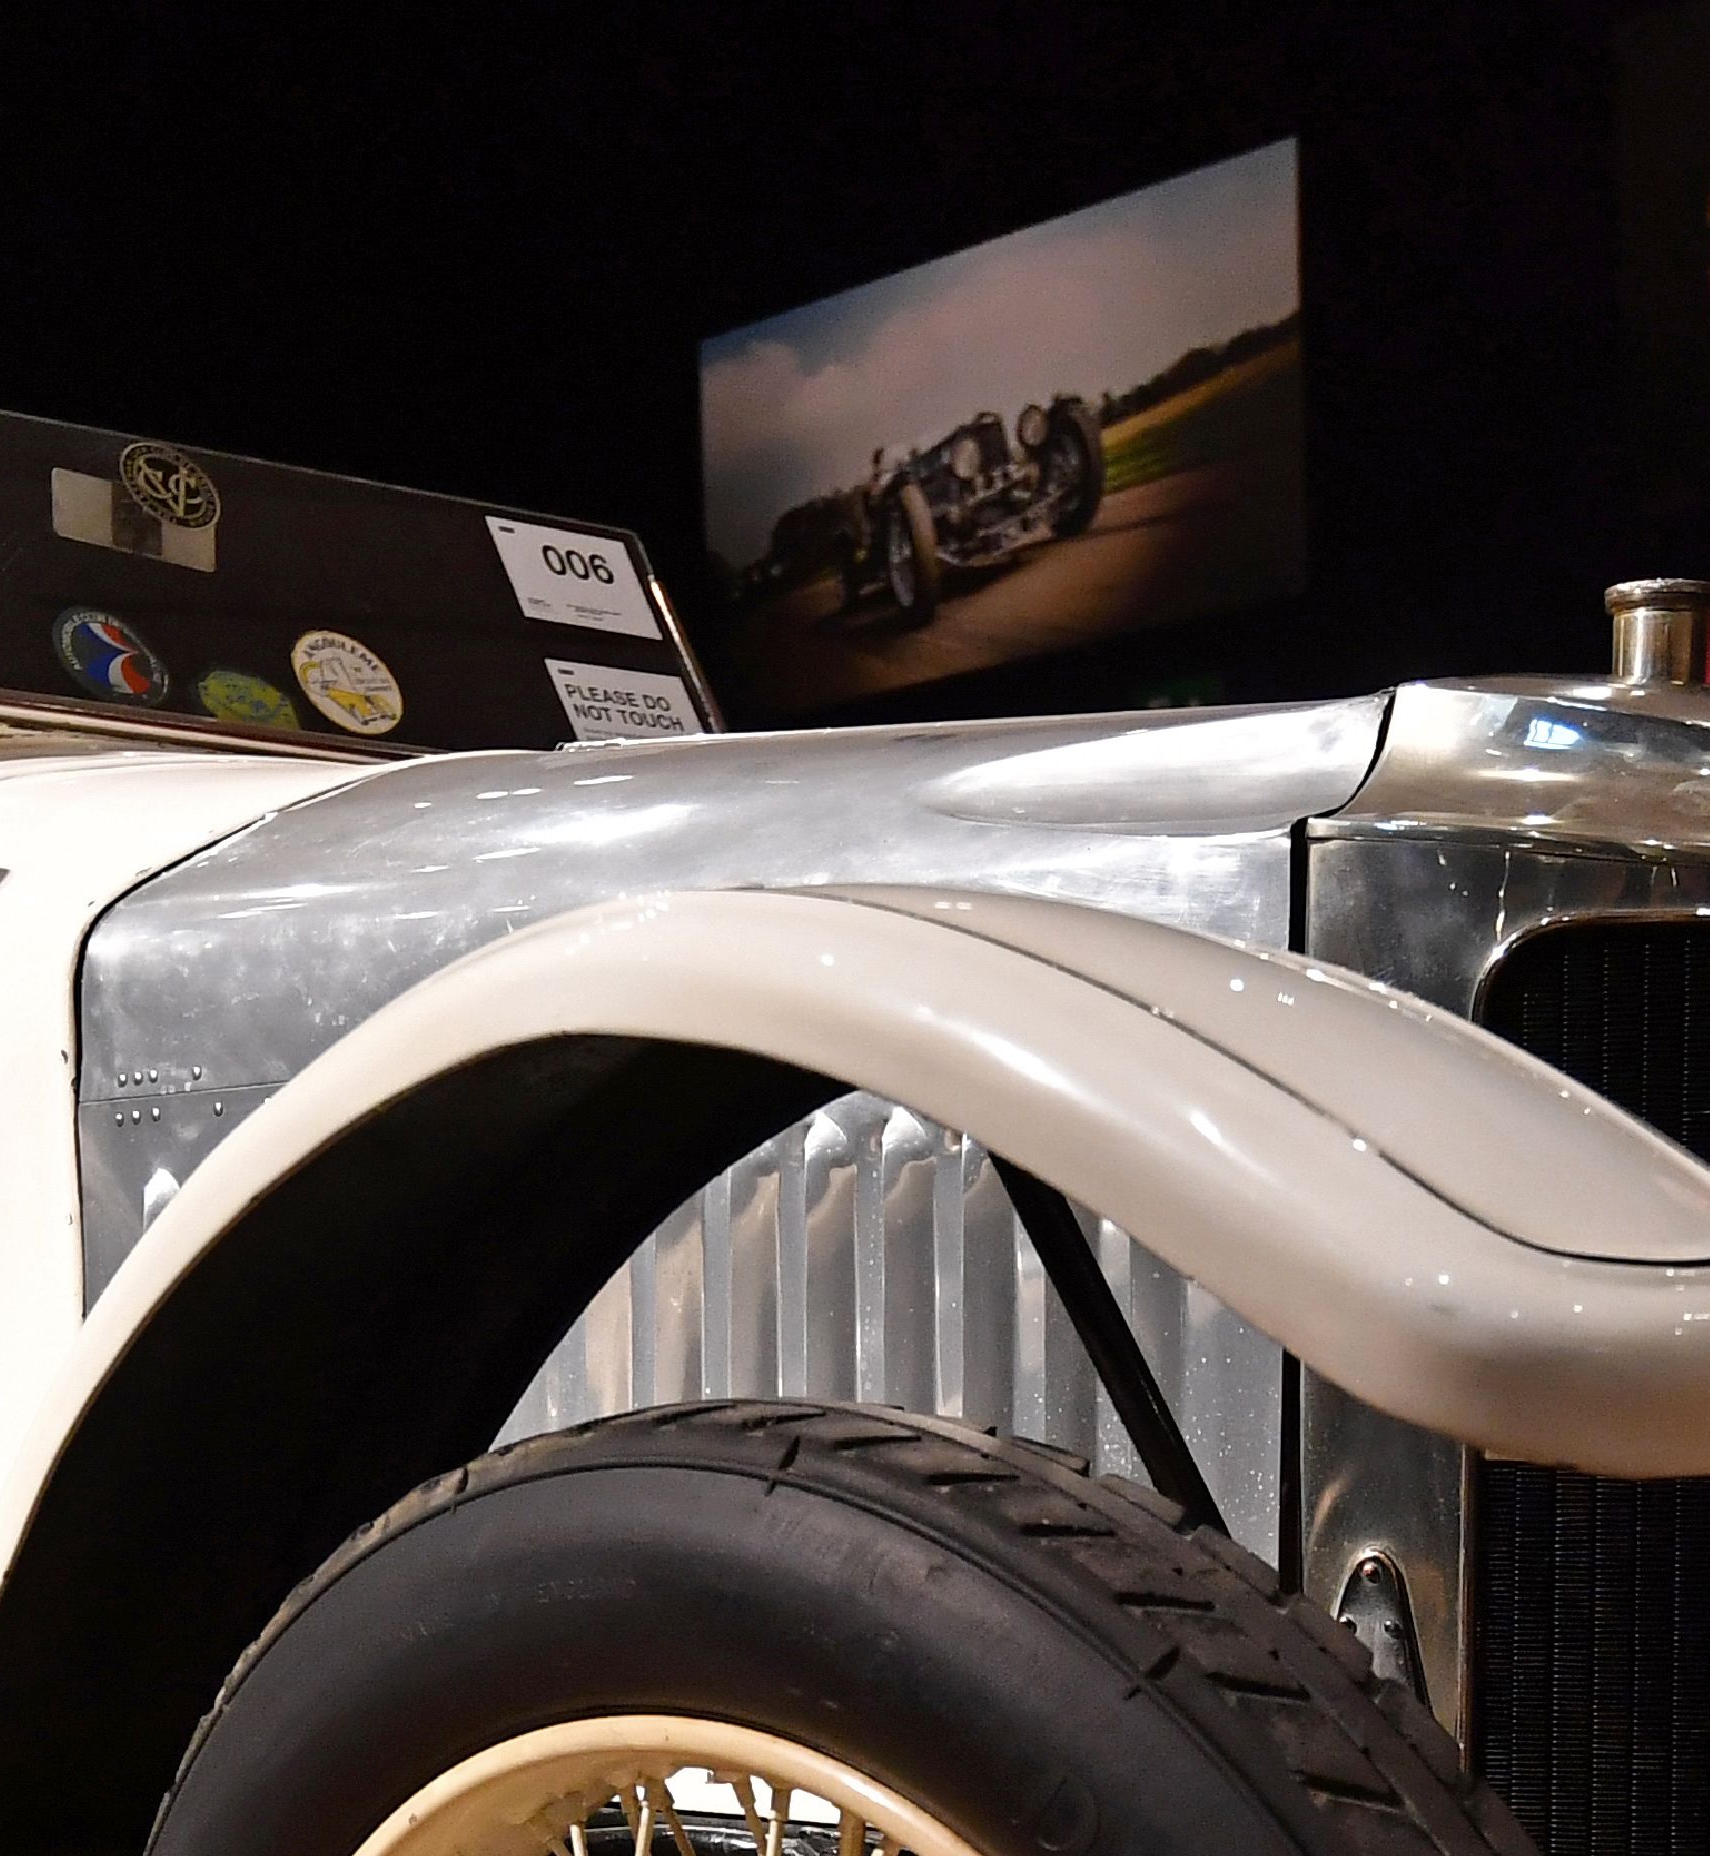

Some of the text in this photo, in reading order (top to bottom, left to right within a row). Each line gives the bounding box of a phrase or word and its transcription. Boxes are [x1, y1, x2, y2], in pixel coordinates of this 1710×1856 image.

[542, 544, 615, 585] 006
[564, 683, 672, 712] PLEASE DO
[572, 703, 685, 732] NOT TOUCH
